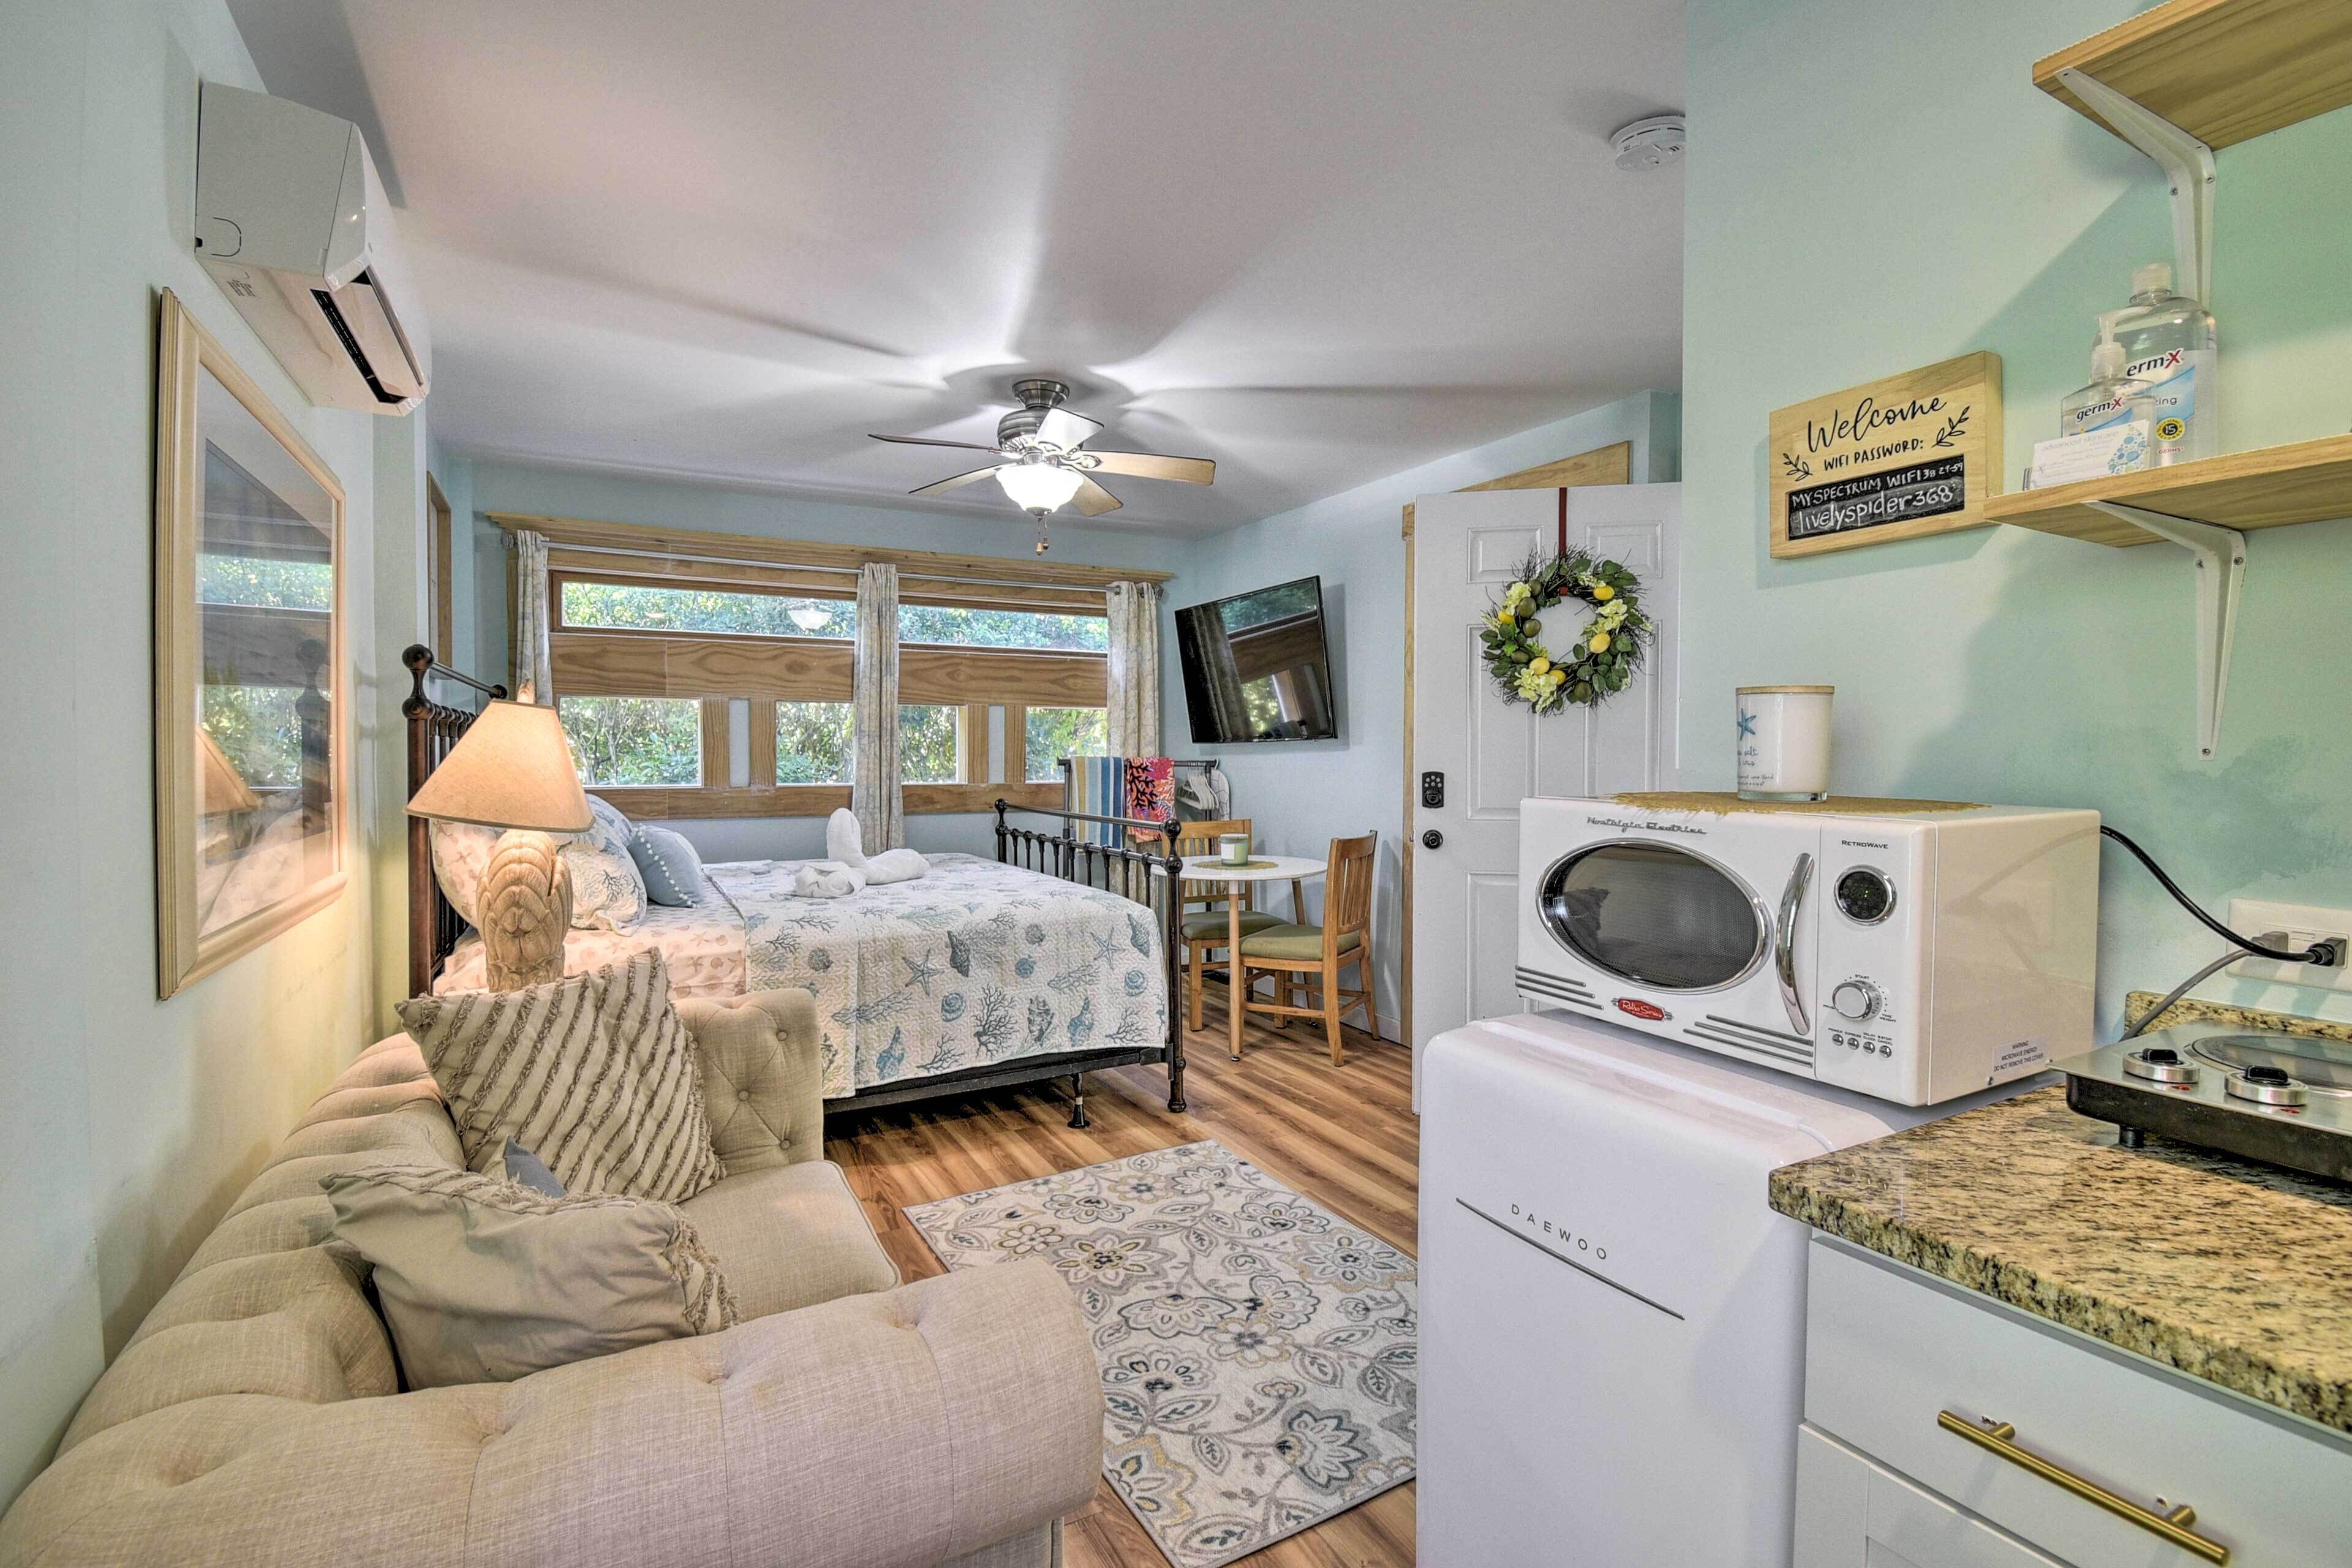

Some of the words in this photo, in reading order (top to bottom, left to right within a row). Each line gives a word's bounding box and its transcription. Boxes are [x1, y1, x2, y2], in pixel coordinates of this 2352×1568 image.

[2127, 350, 2181, 377] erm-X
[1807, 398, 1947, 453] Welcome
[2165, 424, 2176, 434] 15
[1824, 455, 1849, 470] WIFI
[1854, 439, 1923, 464] PASSWORD:
[1799, 485, 1953, 533] livelyspider368
[1623, 1000, 1640, 1011] Retro
[1512, 1204, 1607, 1260] DAEWOO
